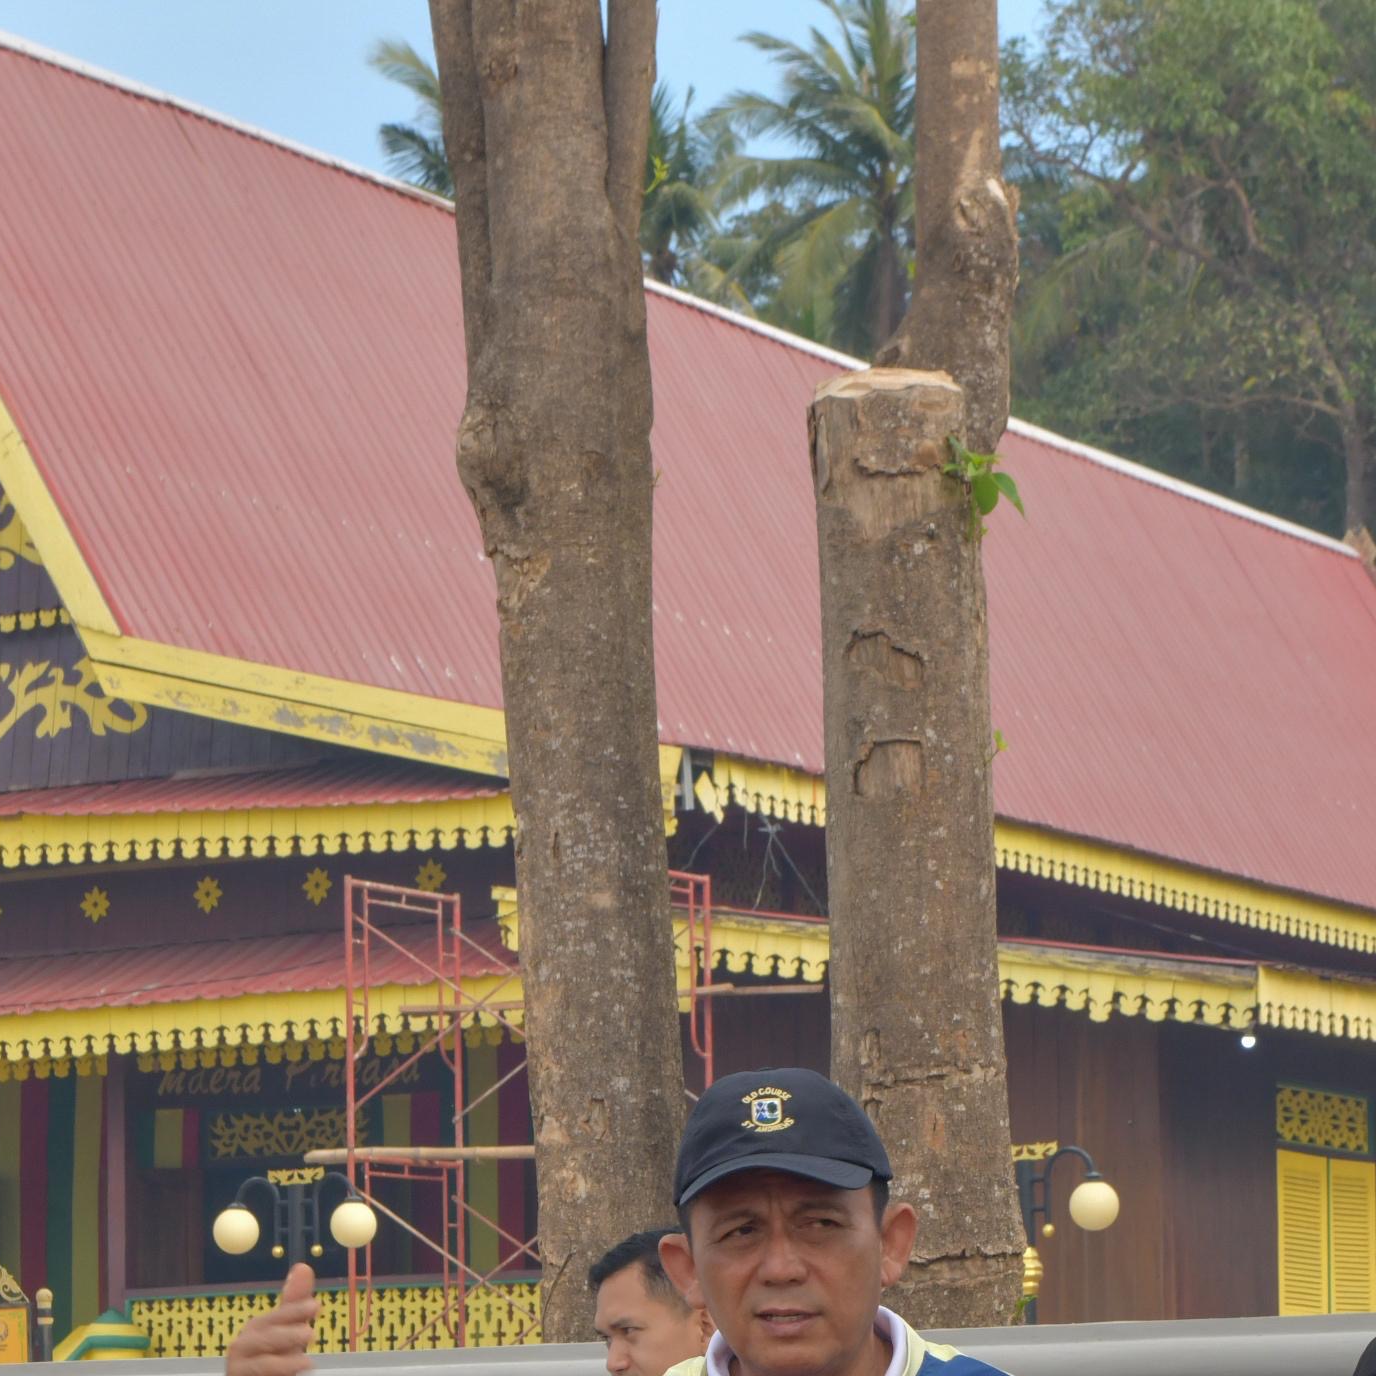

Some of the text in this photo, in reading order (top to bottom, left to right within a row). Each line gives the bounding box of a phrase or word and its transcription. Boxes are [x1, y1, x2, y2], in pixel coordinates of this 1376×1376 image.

[742, 1086, 792, 1104] OLD COURSE
[741, 1117, 795, 1132] ST ANDREWS
